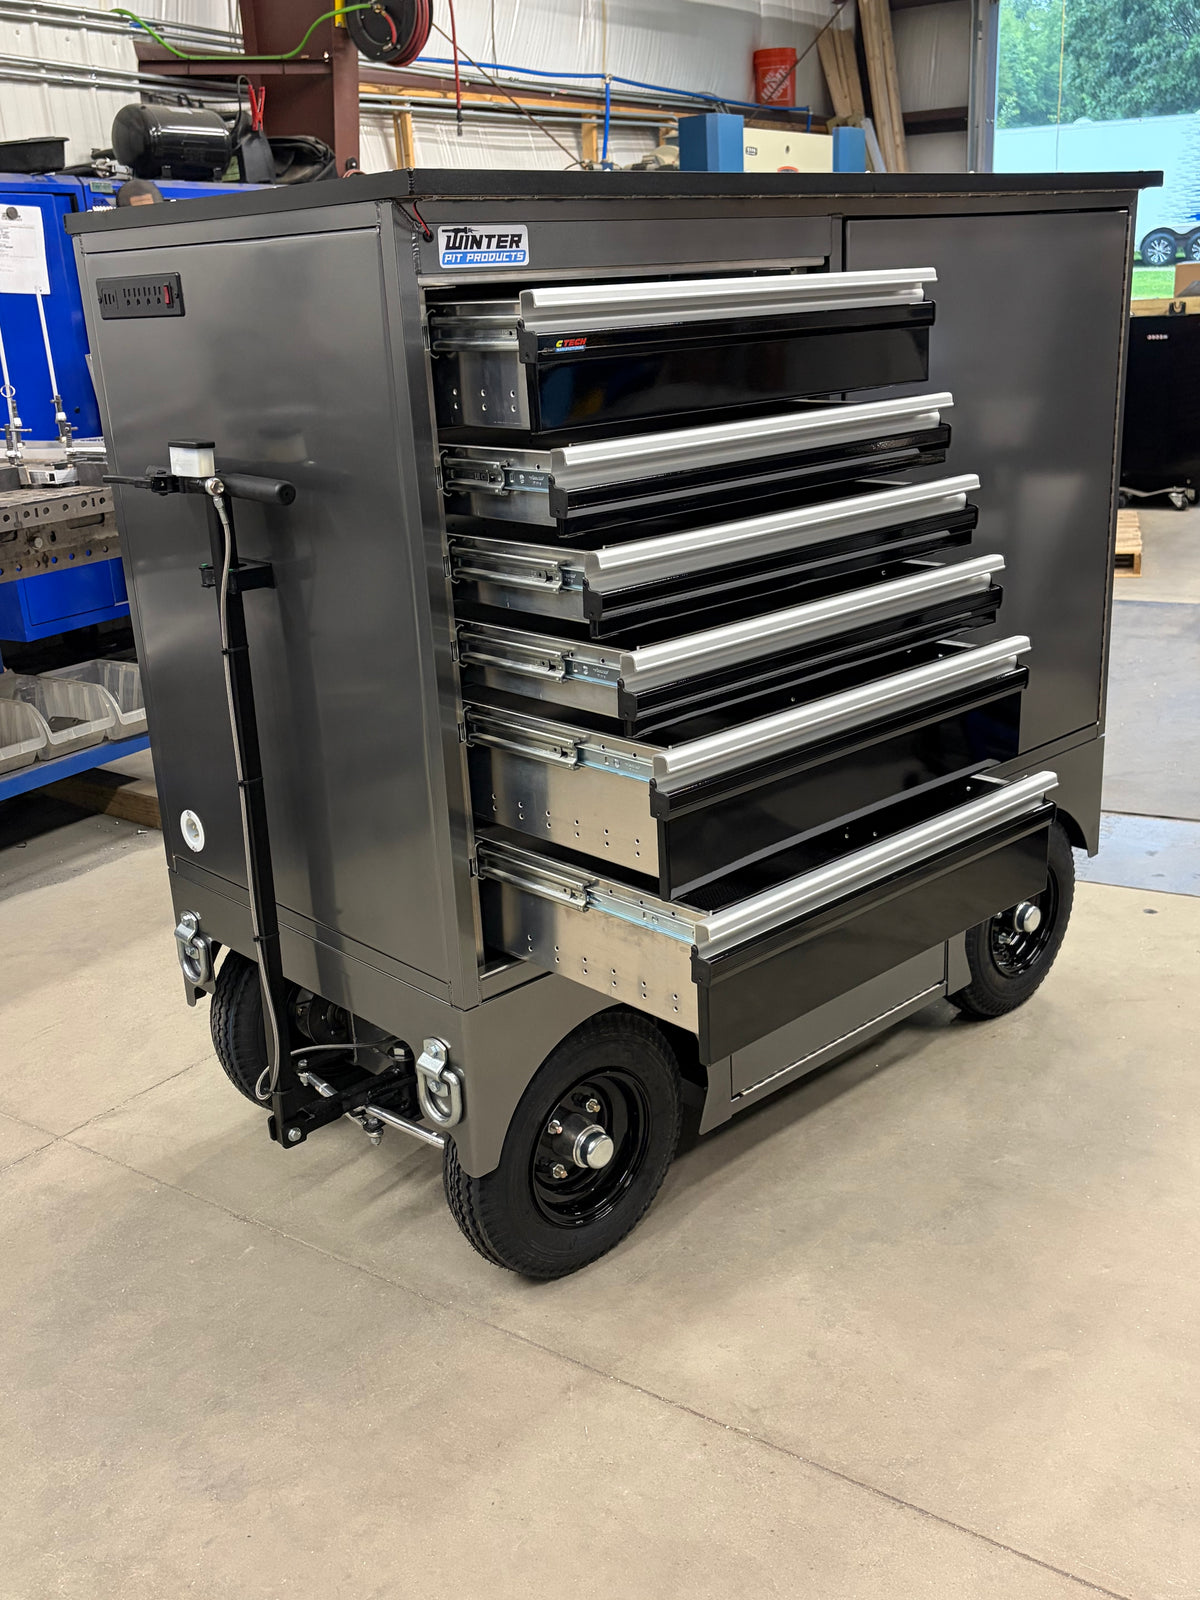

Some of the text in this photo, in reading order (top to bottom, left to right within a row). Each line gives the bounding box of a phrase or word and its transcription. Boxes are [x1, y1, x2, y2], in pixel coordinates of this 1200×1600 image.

[445, 233, 522, 250] WINTER
[444, 251, 524, 263] PIT PRODUCTS
